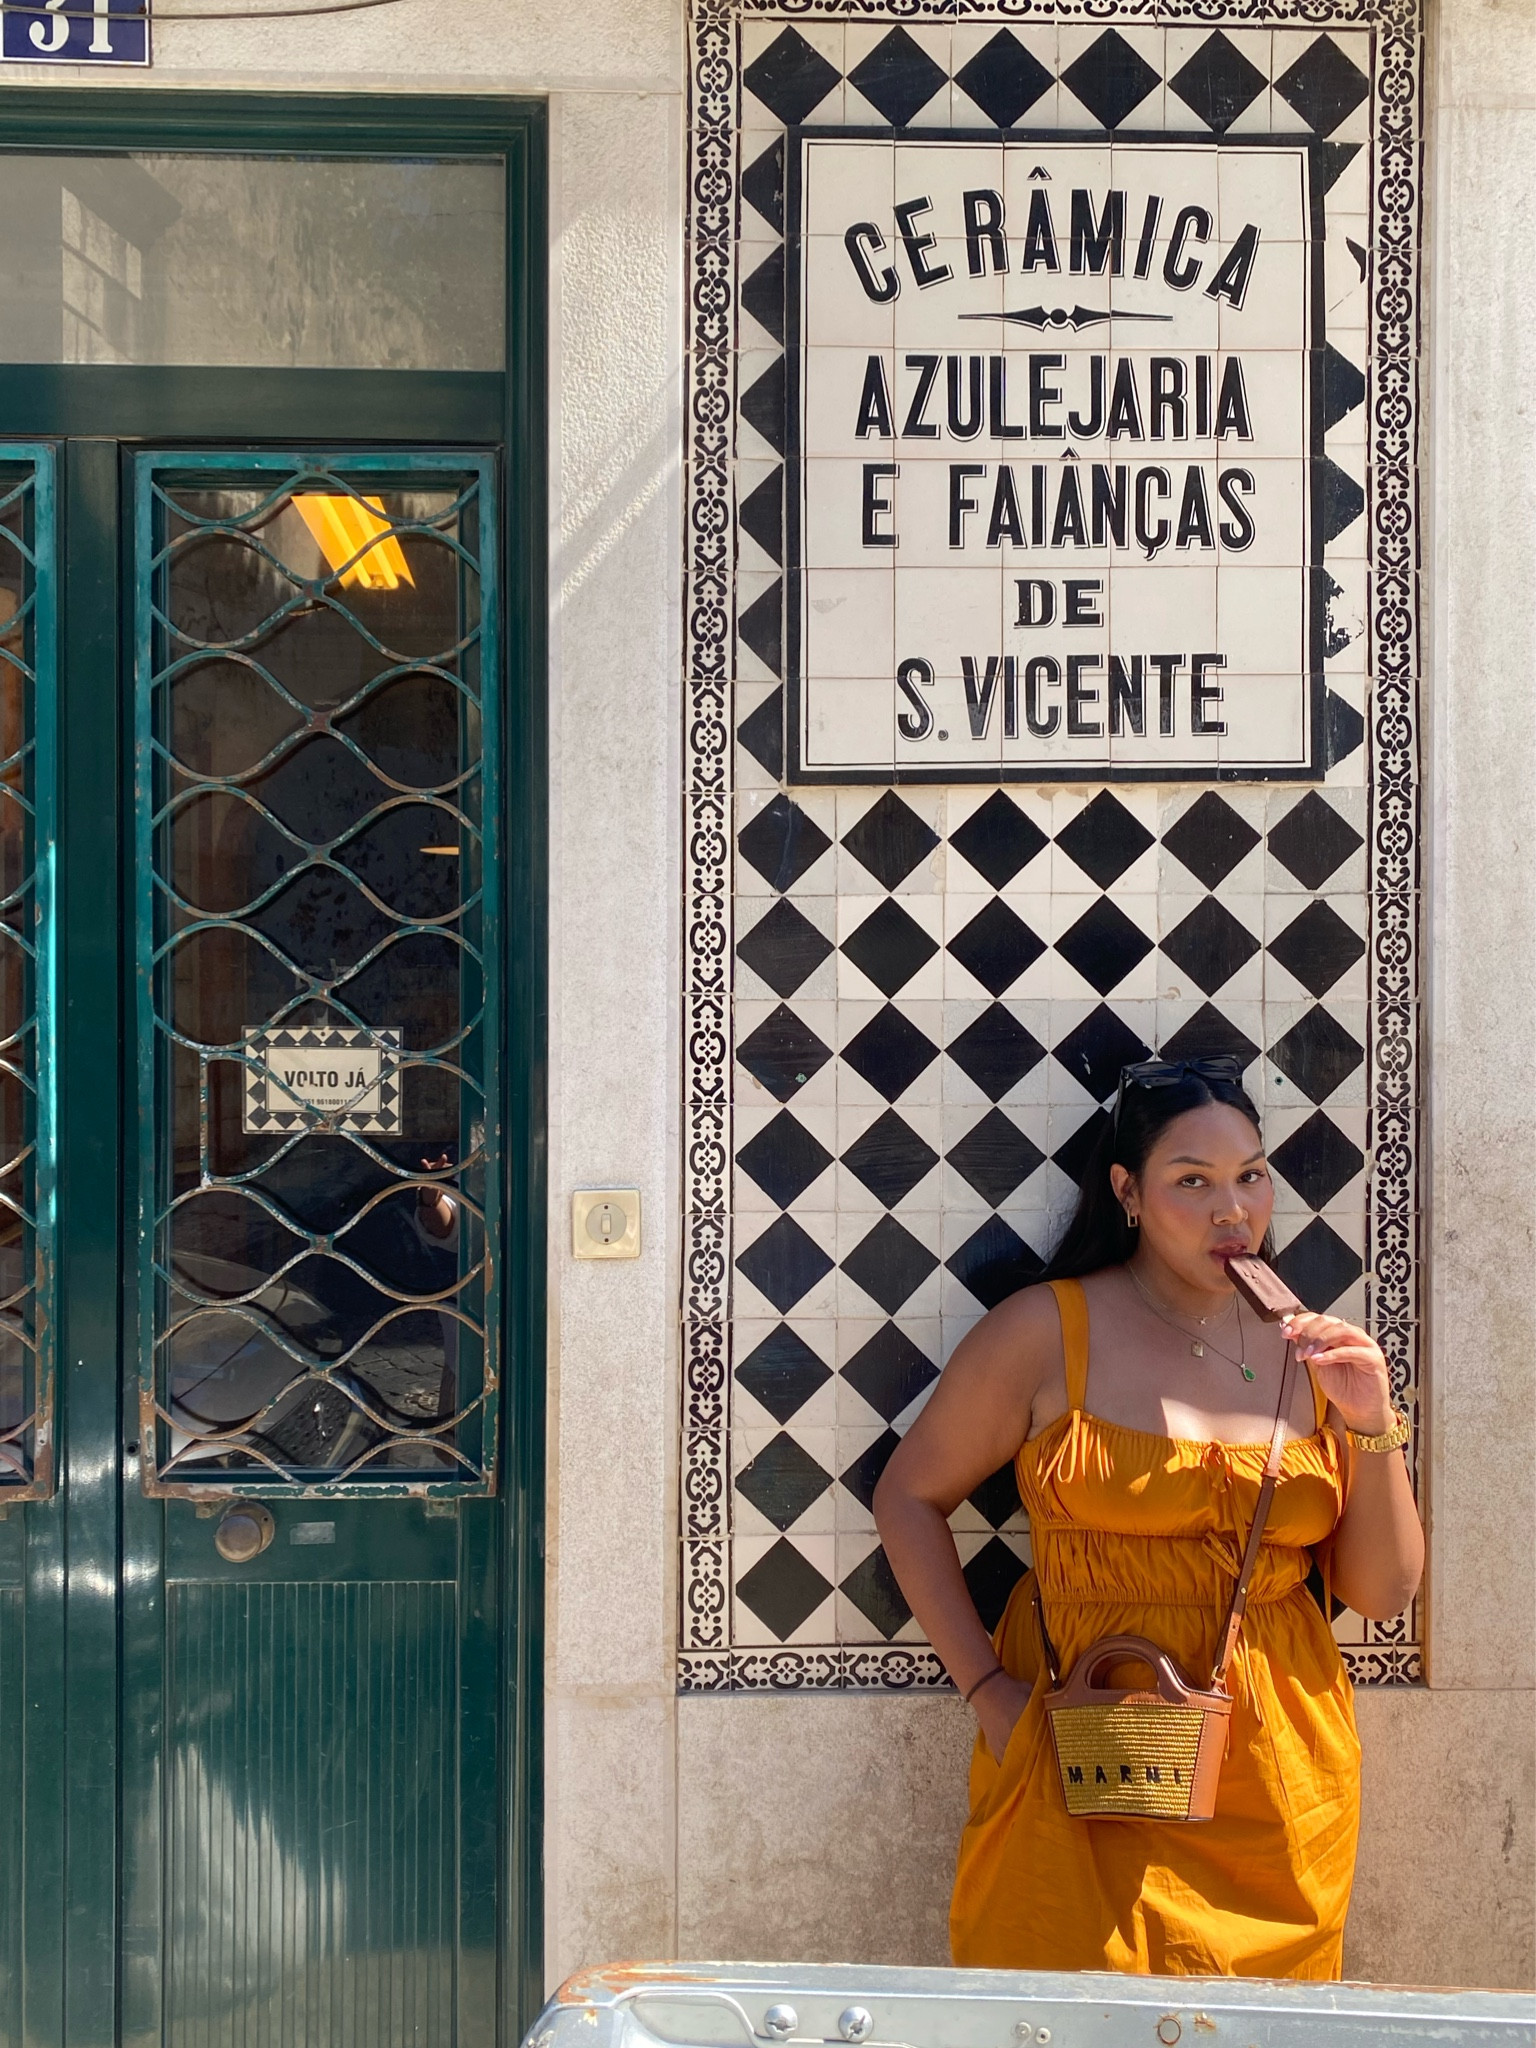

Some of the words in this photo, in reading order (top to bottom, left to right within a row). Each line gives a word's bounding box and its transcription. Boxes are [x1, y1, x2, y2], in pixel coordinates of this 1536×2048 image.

[28, 0, 113, 53] 31
[843, 165, 1262, 311] CERÂMICA
[854, 354, 1254, 441] AZULEJARIA
[861, 463, 899, 548] E
[948, 447, 1256, 561] FAIÂNÇAS
[1013, 578, 1104, 628] DE
[960, 653, 1228, 740] VICENTE
[284, 1070, 339, 1088] VOLTO
[344, 1066, 366, 1088] JÁ
[1067, 1764, 1182, 1784] MARNI
